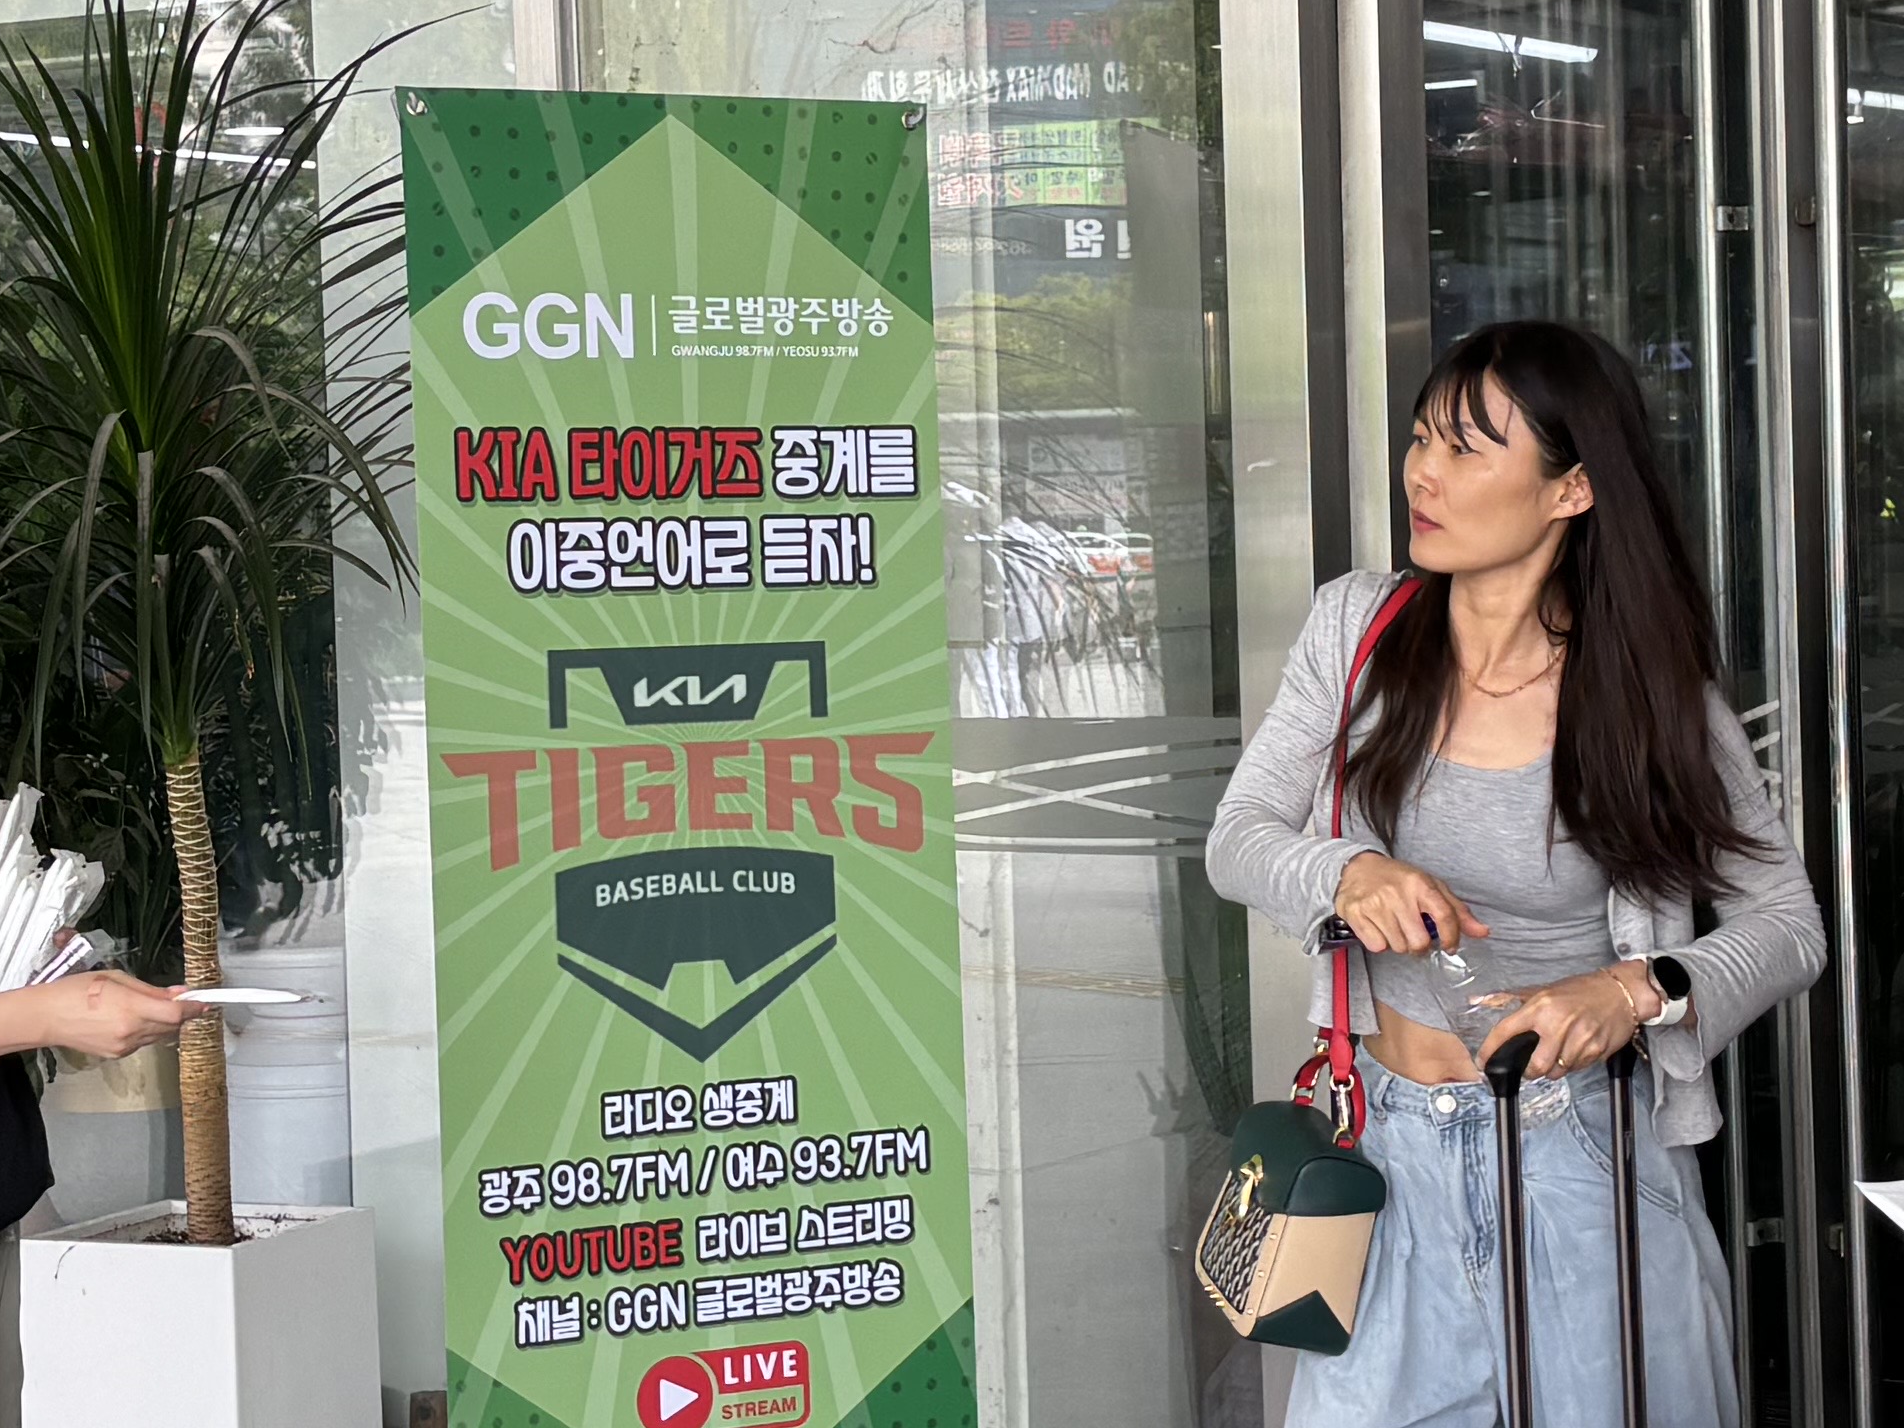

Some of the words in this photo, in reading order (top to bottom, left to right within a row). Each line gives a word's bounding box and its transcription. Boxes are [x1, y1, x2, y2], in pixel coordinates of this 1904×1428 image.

[462, 291, 635, 360] GGN
[668, 295, 894, 338] 글로벌광주방송
[671, 344, 734, 357] GWANGJU
[735, 344, 774, 357] 98.7FM
[783, 345, 822, 357] YEOSU
[822, 345, 859, 358] 93.7FM
[454, 427, 558, 501] KIA
[570, 428, 762, 498] 타이거즈
[773, 427, 917, 497] 중계를
[509, 517, 751, 592] 이중언어로
[761, 516, 874, 585] 듣자!
[439, 730, 936, 872] TIGERS
[595, 871, 725, 908] BASEBALL
[732, 870, 796, 894] CLUB
[603, 1088, 695, 1137] 라디오
[702, 1078, 796, 1125] 생중계
[481, 1167, 542, 1215] 광주
[550, 1149, 690, 1207] 98.7FM
[699, 1148, 716, 1192] /
[725, 1142, 786, 1188] 여수
[794, 1129, 928, 1181] 93.7FM
[501, 1222, 683, 1284] YOUTUBE
[698, 1210, 789, 1259] 라이브
[796, 1197, 914, 1249] 스트리밍
[517, 1296, 580, 1346] 채널
[607, 1283, 687, 1333] GGN
[695, 1261, 903, 1323] 글로벌광주방송
[723, 1349, 798, 1385] LIVE
[721, 1396, 797, 1420] STREAM
